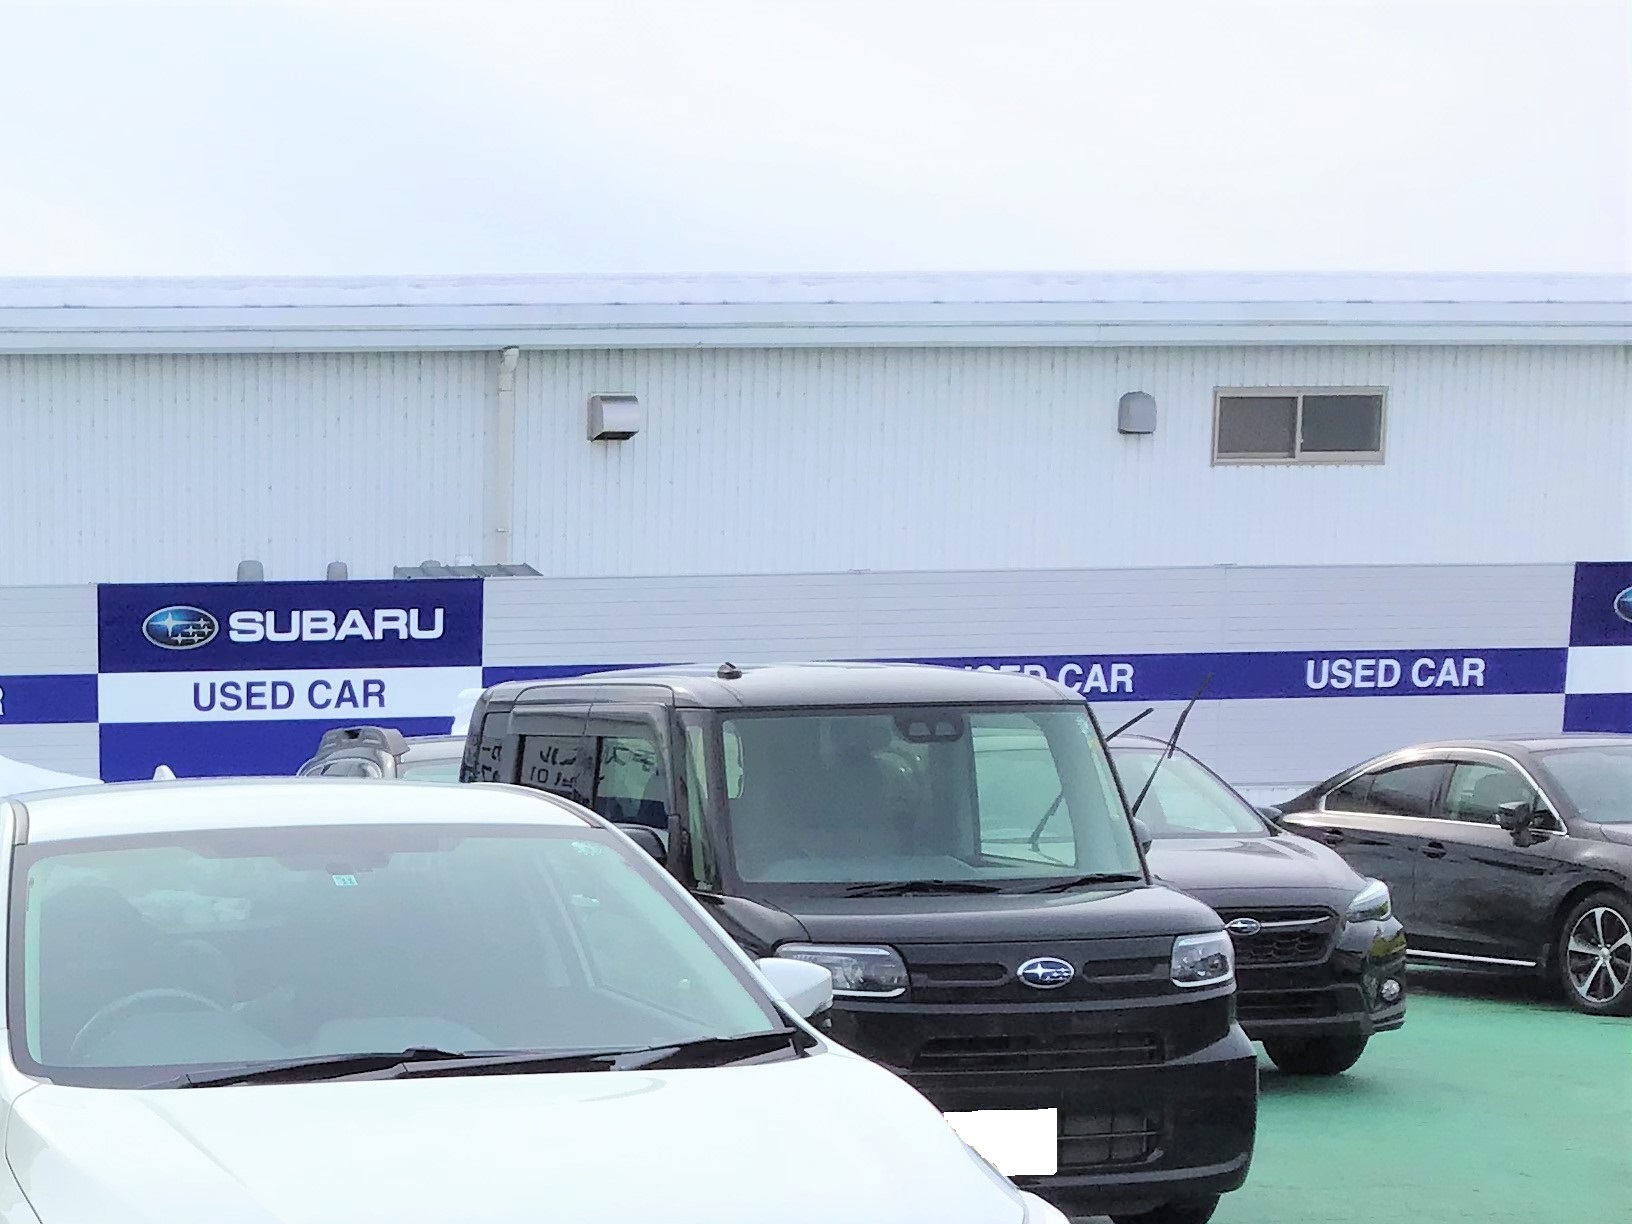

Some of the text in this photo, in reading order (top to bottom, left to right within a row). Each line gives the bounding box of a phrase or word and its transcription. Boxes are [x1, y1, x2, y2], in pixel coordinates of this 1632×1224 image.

[228, 608, 444, 643] SUBARU
[1058, 663, 1134, 693] CAR
[1306, 656, 1486, 691] USED CAR
[193, 678, 386, 712] USED CAR
